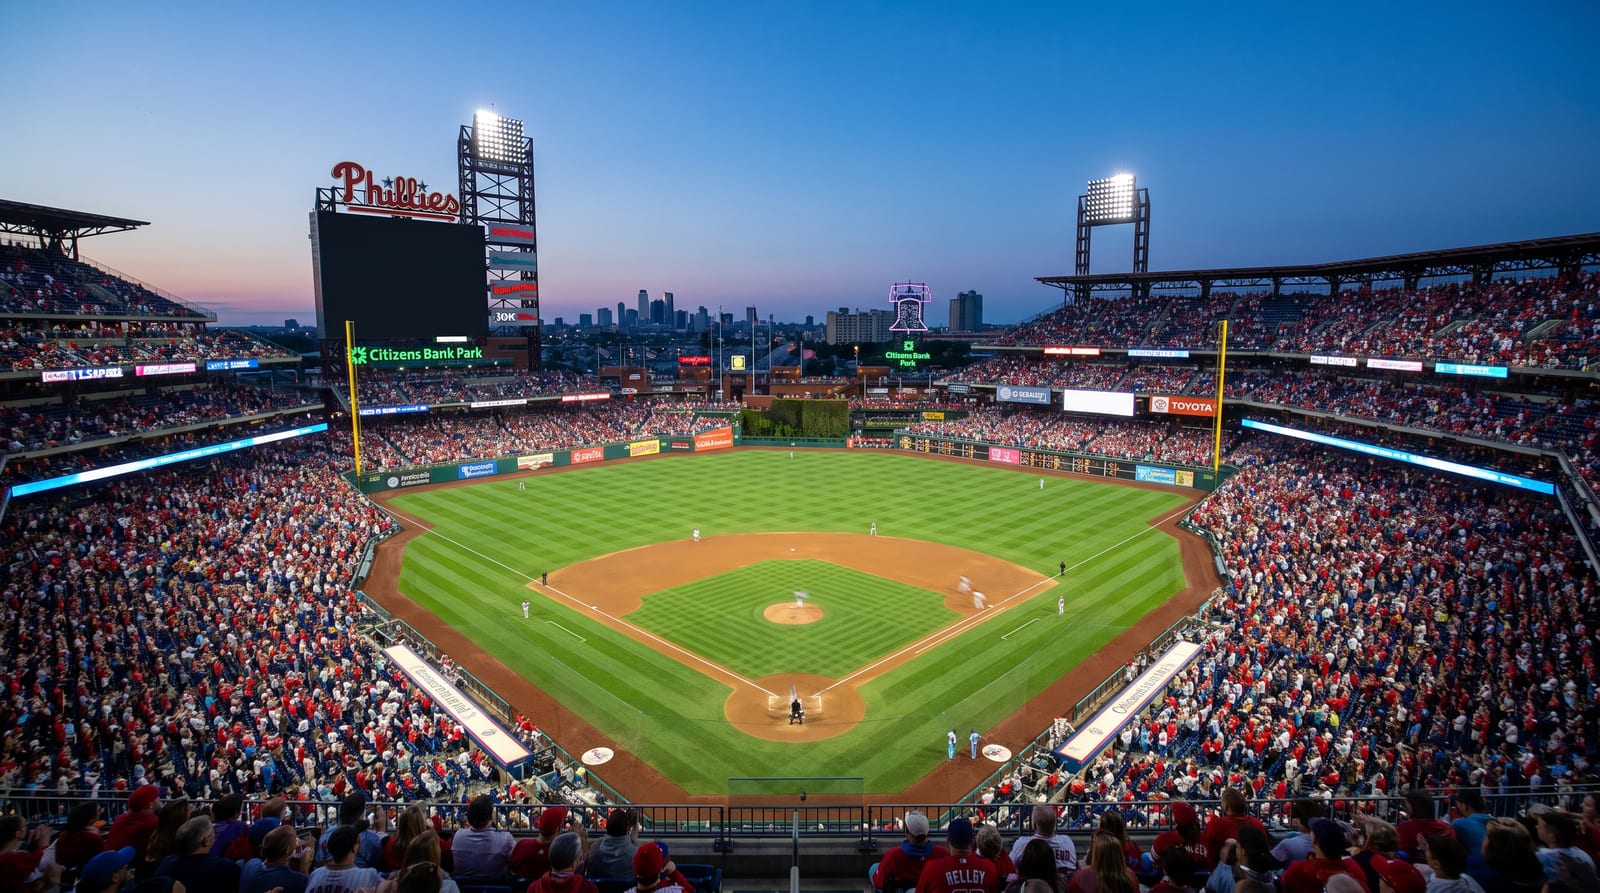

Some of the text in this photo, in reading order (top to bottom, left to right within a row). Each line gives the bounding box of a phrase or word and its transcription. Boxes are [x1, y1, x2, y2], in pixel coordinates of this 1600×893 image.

[331, 161, 461, 214] Phillies
[369, 346, 483, 361] Citizens Bank Park
[912, 352, 931, 360] Bank
[1171, 401, 1213, 412] TOYOTA
